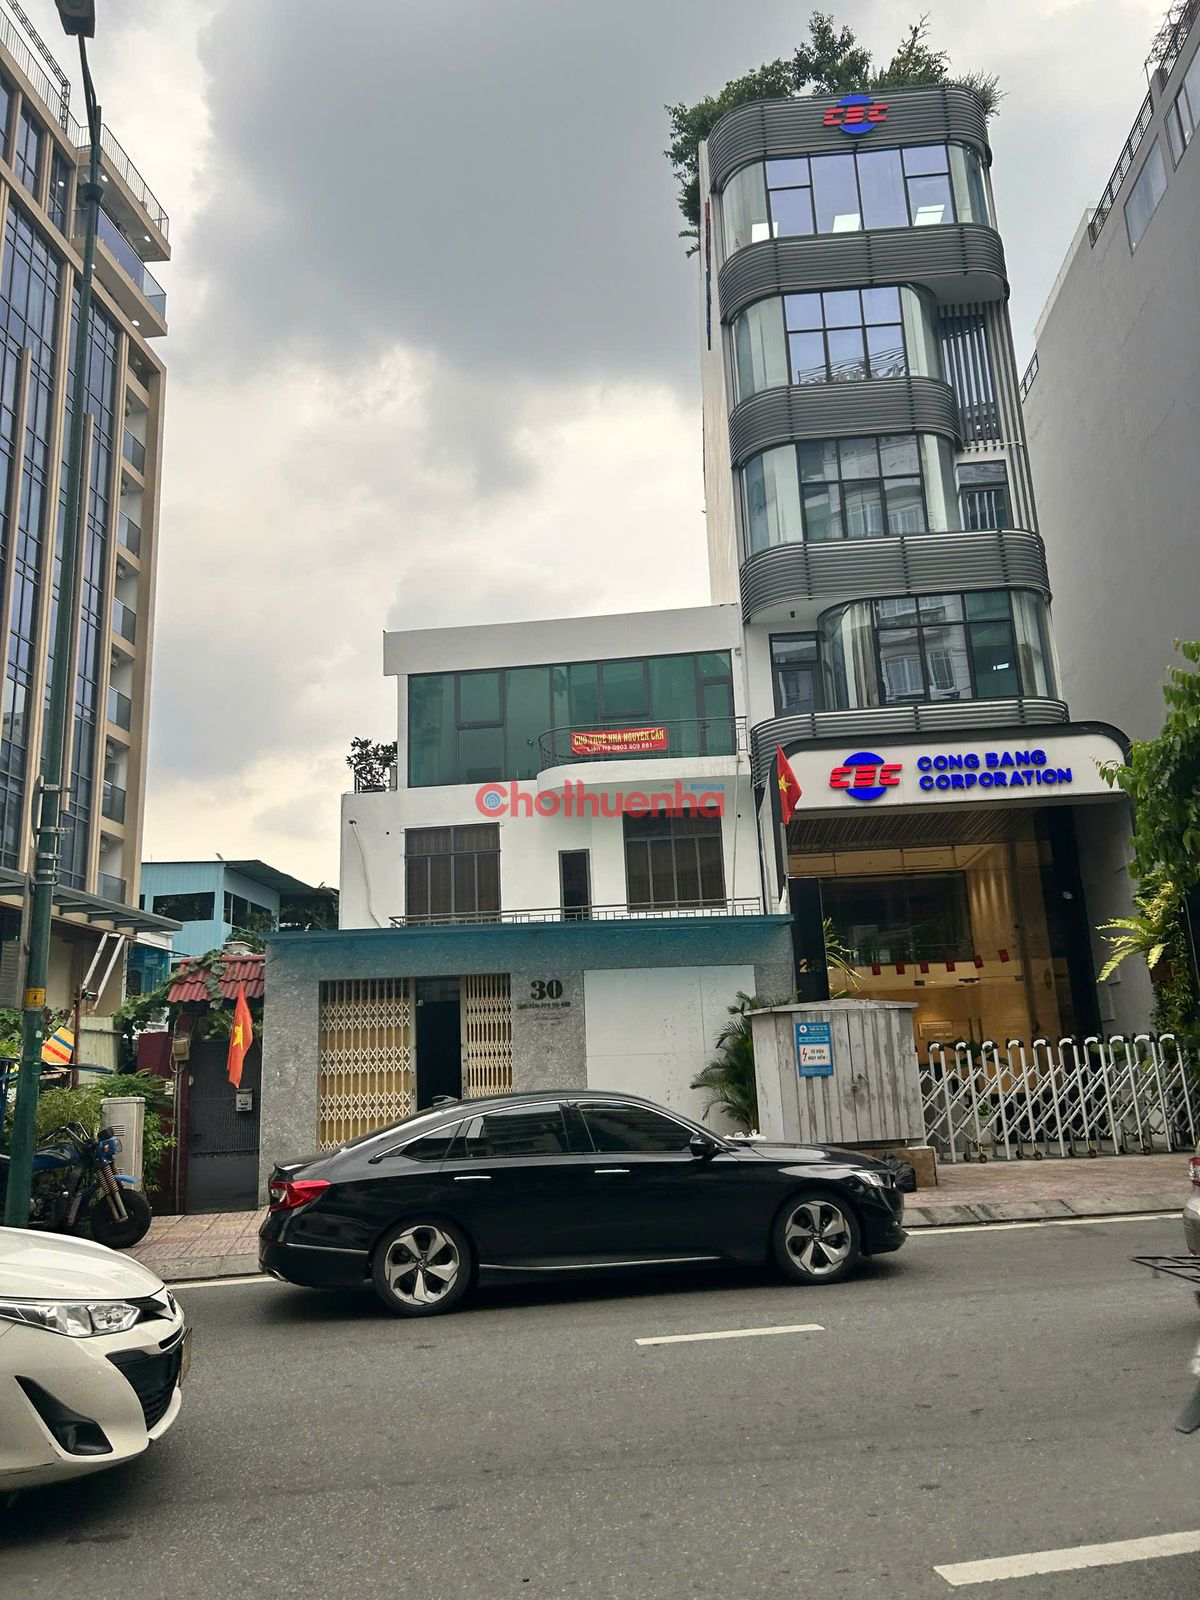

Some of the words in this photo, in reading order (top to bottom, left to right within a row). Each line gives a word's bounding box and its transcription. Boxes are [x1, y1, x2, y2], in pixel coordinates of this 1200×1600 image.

[917, 753, 980, 772] CONG
[985, 749, 1047, 768] BANG
[829, 764, 902, 788] CBC
[919, 768, 1073, 791] CORPORATION
[530, 979, 563, 1000] 30
